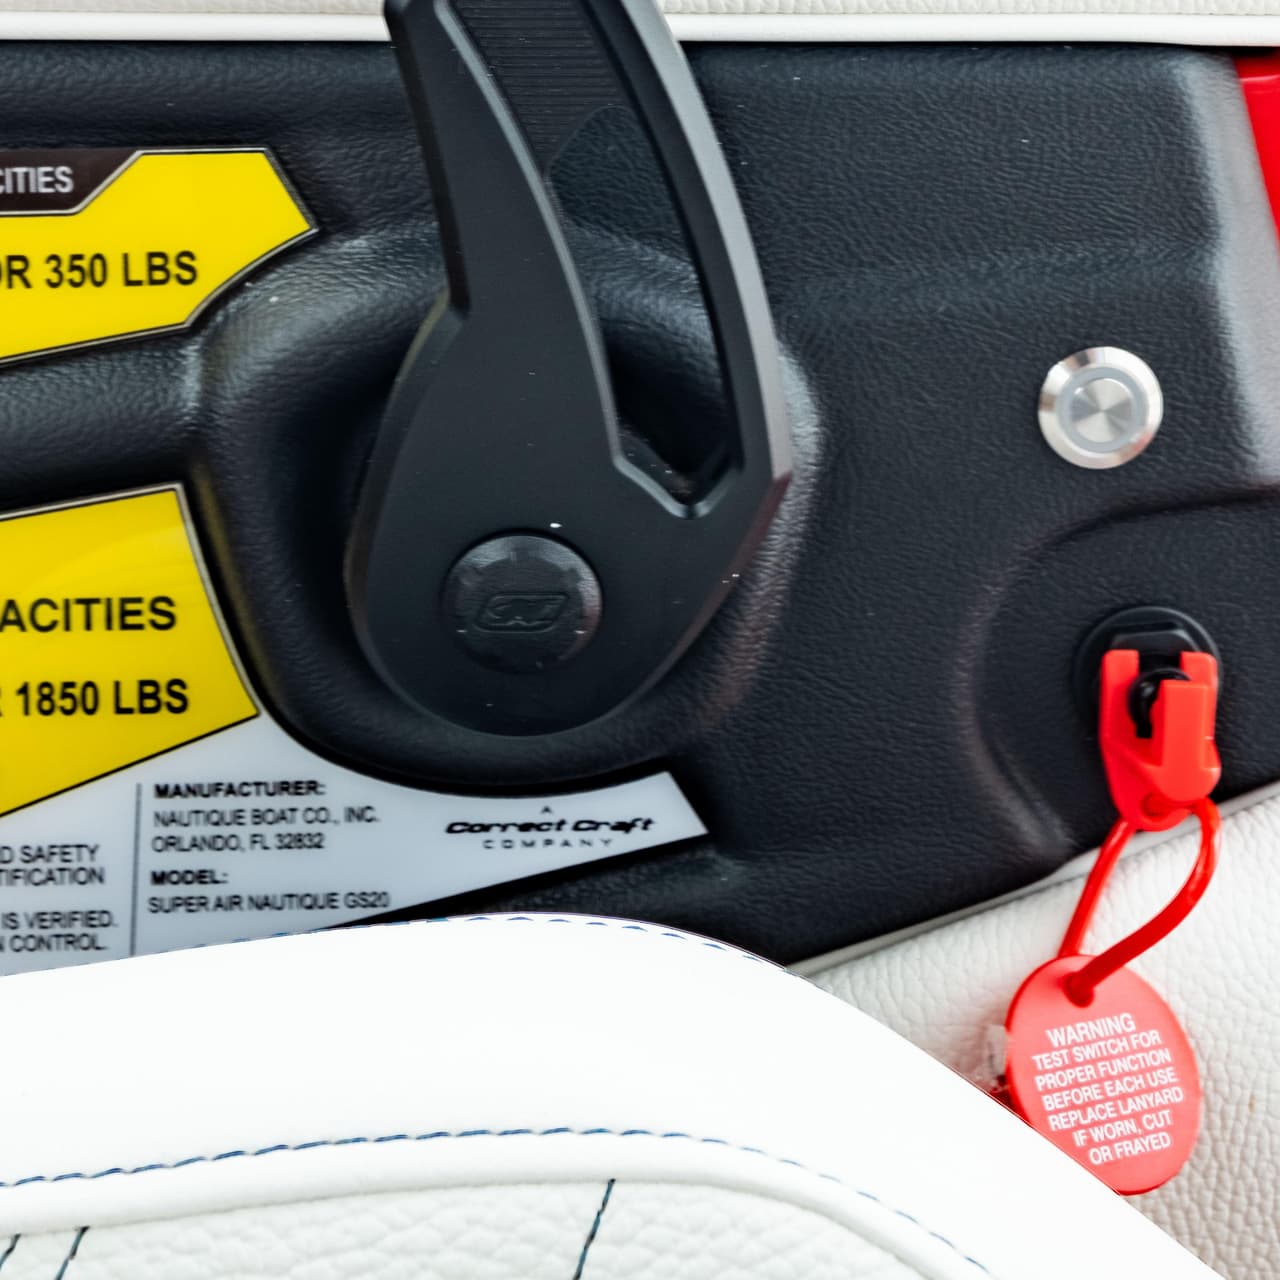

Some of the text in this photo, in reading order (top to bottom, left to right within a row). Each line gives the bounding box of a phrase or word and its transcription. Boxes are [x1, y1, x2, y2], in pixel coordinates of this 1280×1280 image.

[44, 252, 107, 289] 350
[122, 250, 198, 286] LBS
[16, 680, 98, 716] 1850
[114, 678, 189, 715] LBS
[154, 780, 326, 799] MANUFACTURER:
[154, 808, 246, 827] NAUTIQUE
[251, 808, 299, 825] BOAT
[344, 806, 380, 823] INC.
[446, 818, 655, 834] Correct Craft
[21, 844, 99, 864] SAFETY
[151, 832, 325, 853] ORLANDO, FL 32832
[150, 870, 228, 885] MODEL:
[147, 891, 390, 913] SUPER AIR NAUTIQUE GS20
[2, 912, 19, 931] IS
[25, 909, 117, 930] VERIFIED.
[1047, 1014, 1136, 1047] WARNING
[1032, 1029, 1162, 1071] TEST SWITCH FOR
[1034, 1047, 1173, 1092] PROPER FUNCTION
[1041, 1066, 1178, 1112] BEFORE EACH USE
[1047, 1086, 1185, 1131] REPLACE LANYARD
[1073, 1109, 1173, 1147] IF WORN, CUT
[1088, 1132, 1172, 1166] OR FRAYED
